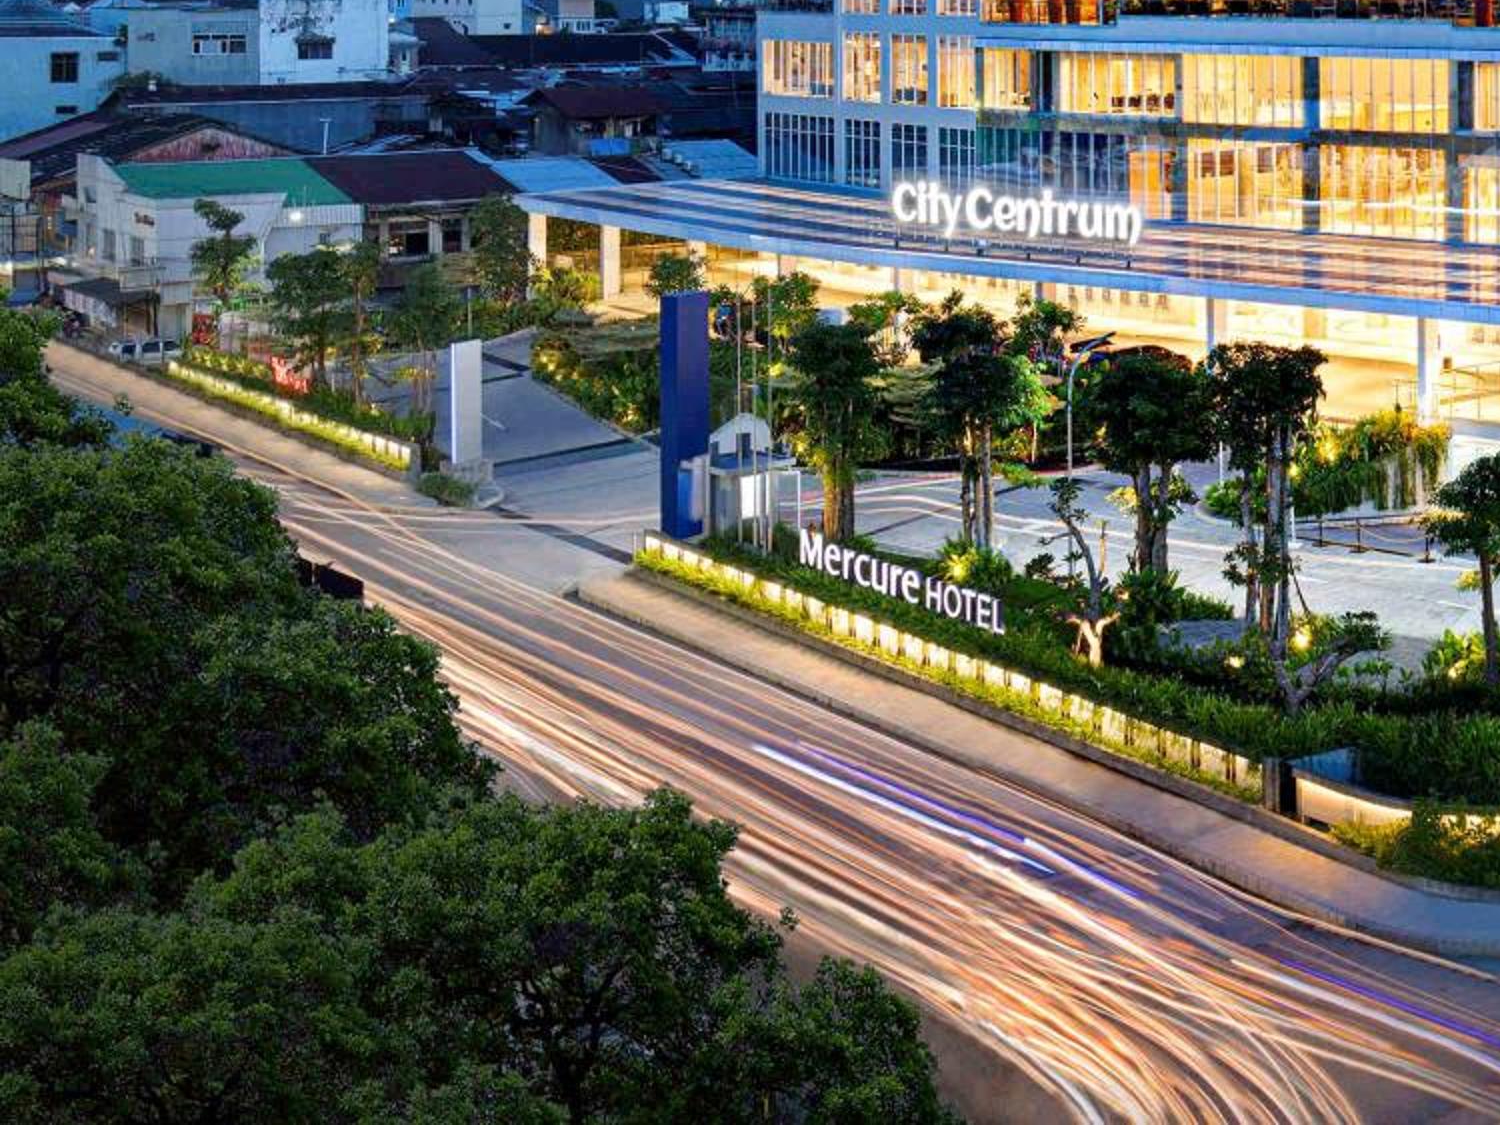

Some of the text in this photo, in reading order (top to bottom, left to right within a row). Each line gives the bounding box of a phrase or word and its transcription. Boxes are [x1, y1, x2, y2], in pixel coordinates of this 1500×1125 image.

[892, 181, 1142, 246] City Centrum
[800, 528, 1005, 635] Mercure HOTEL
